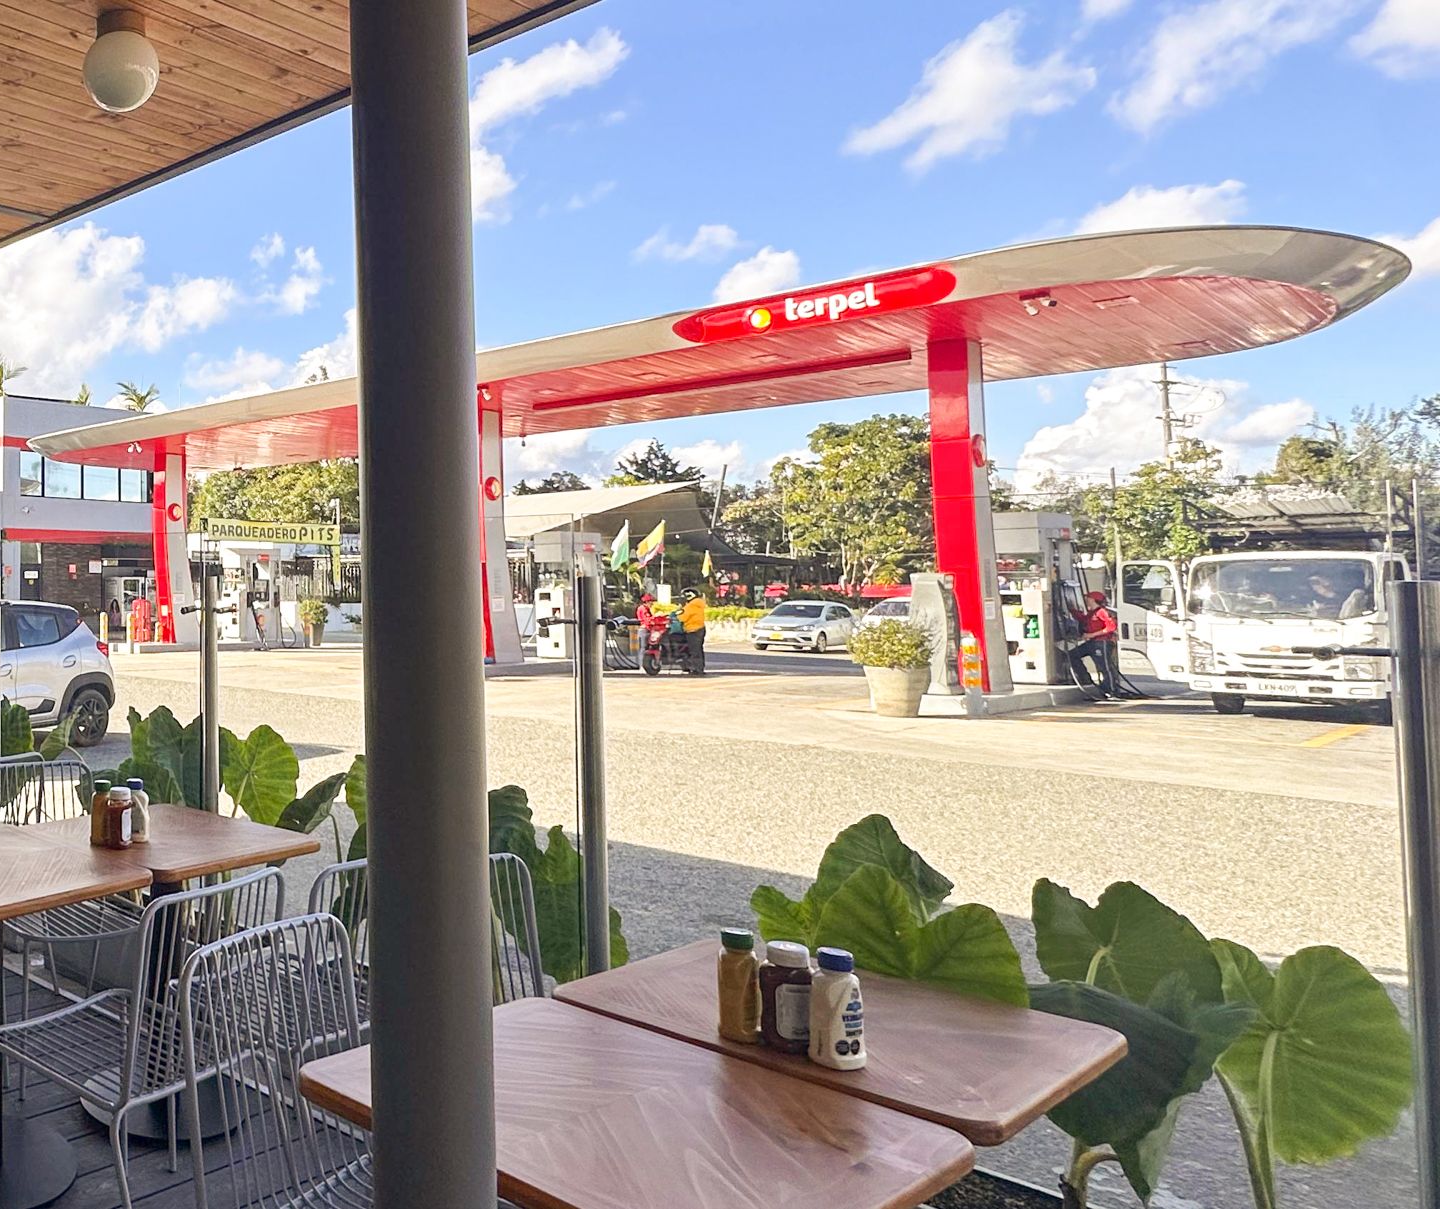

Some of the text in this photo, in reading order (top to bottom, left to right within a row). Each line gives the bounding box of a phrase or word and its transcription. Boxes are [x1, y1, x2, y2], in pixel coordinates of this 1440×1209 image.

[785, 282, 880, 321] terpel
[212, 525, 334, 541] PARQUEADERO PITS
